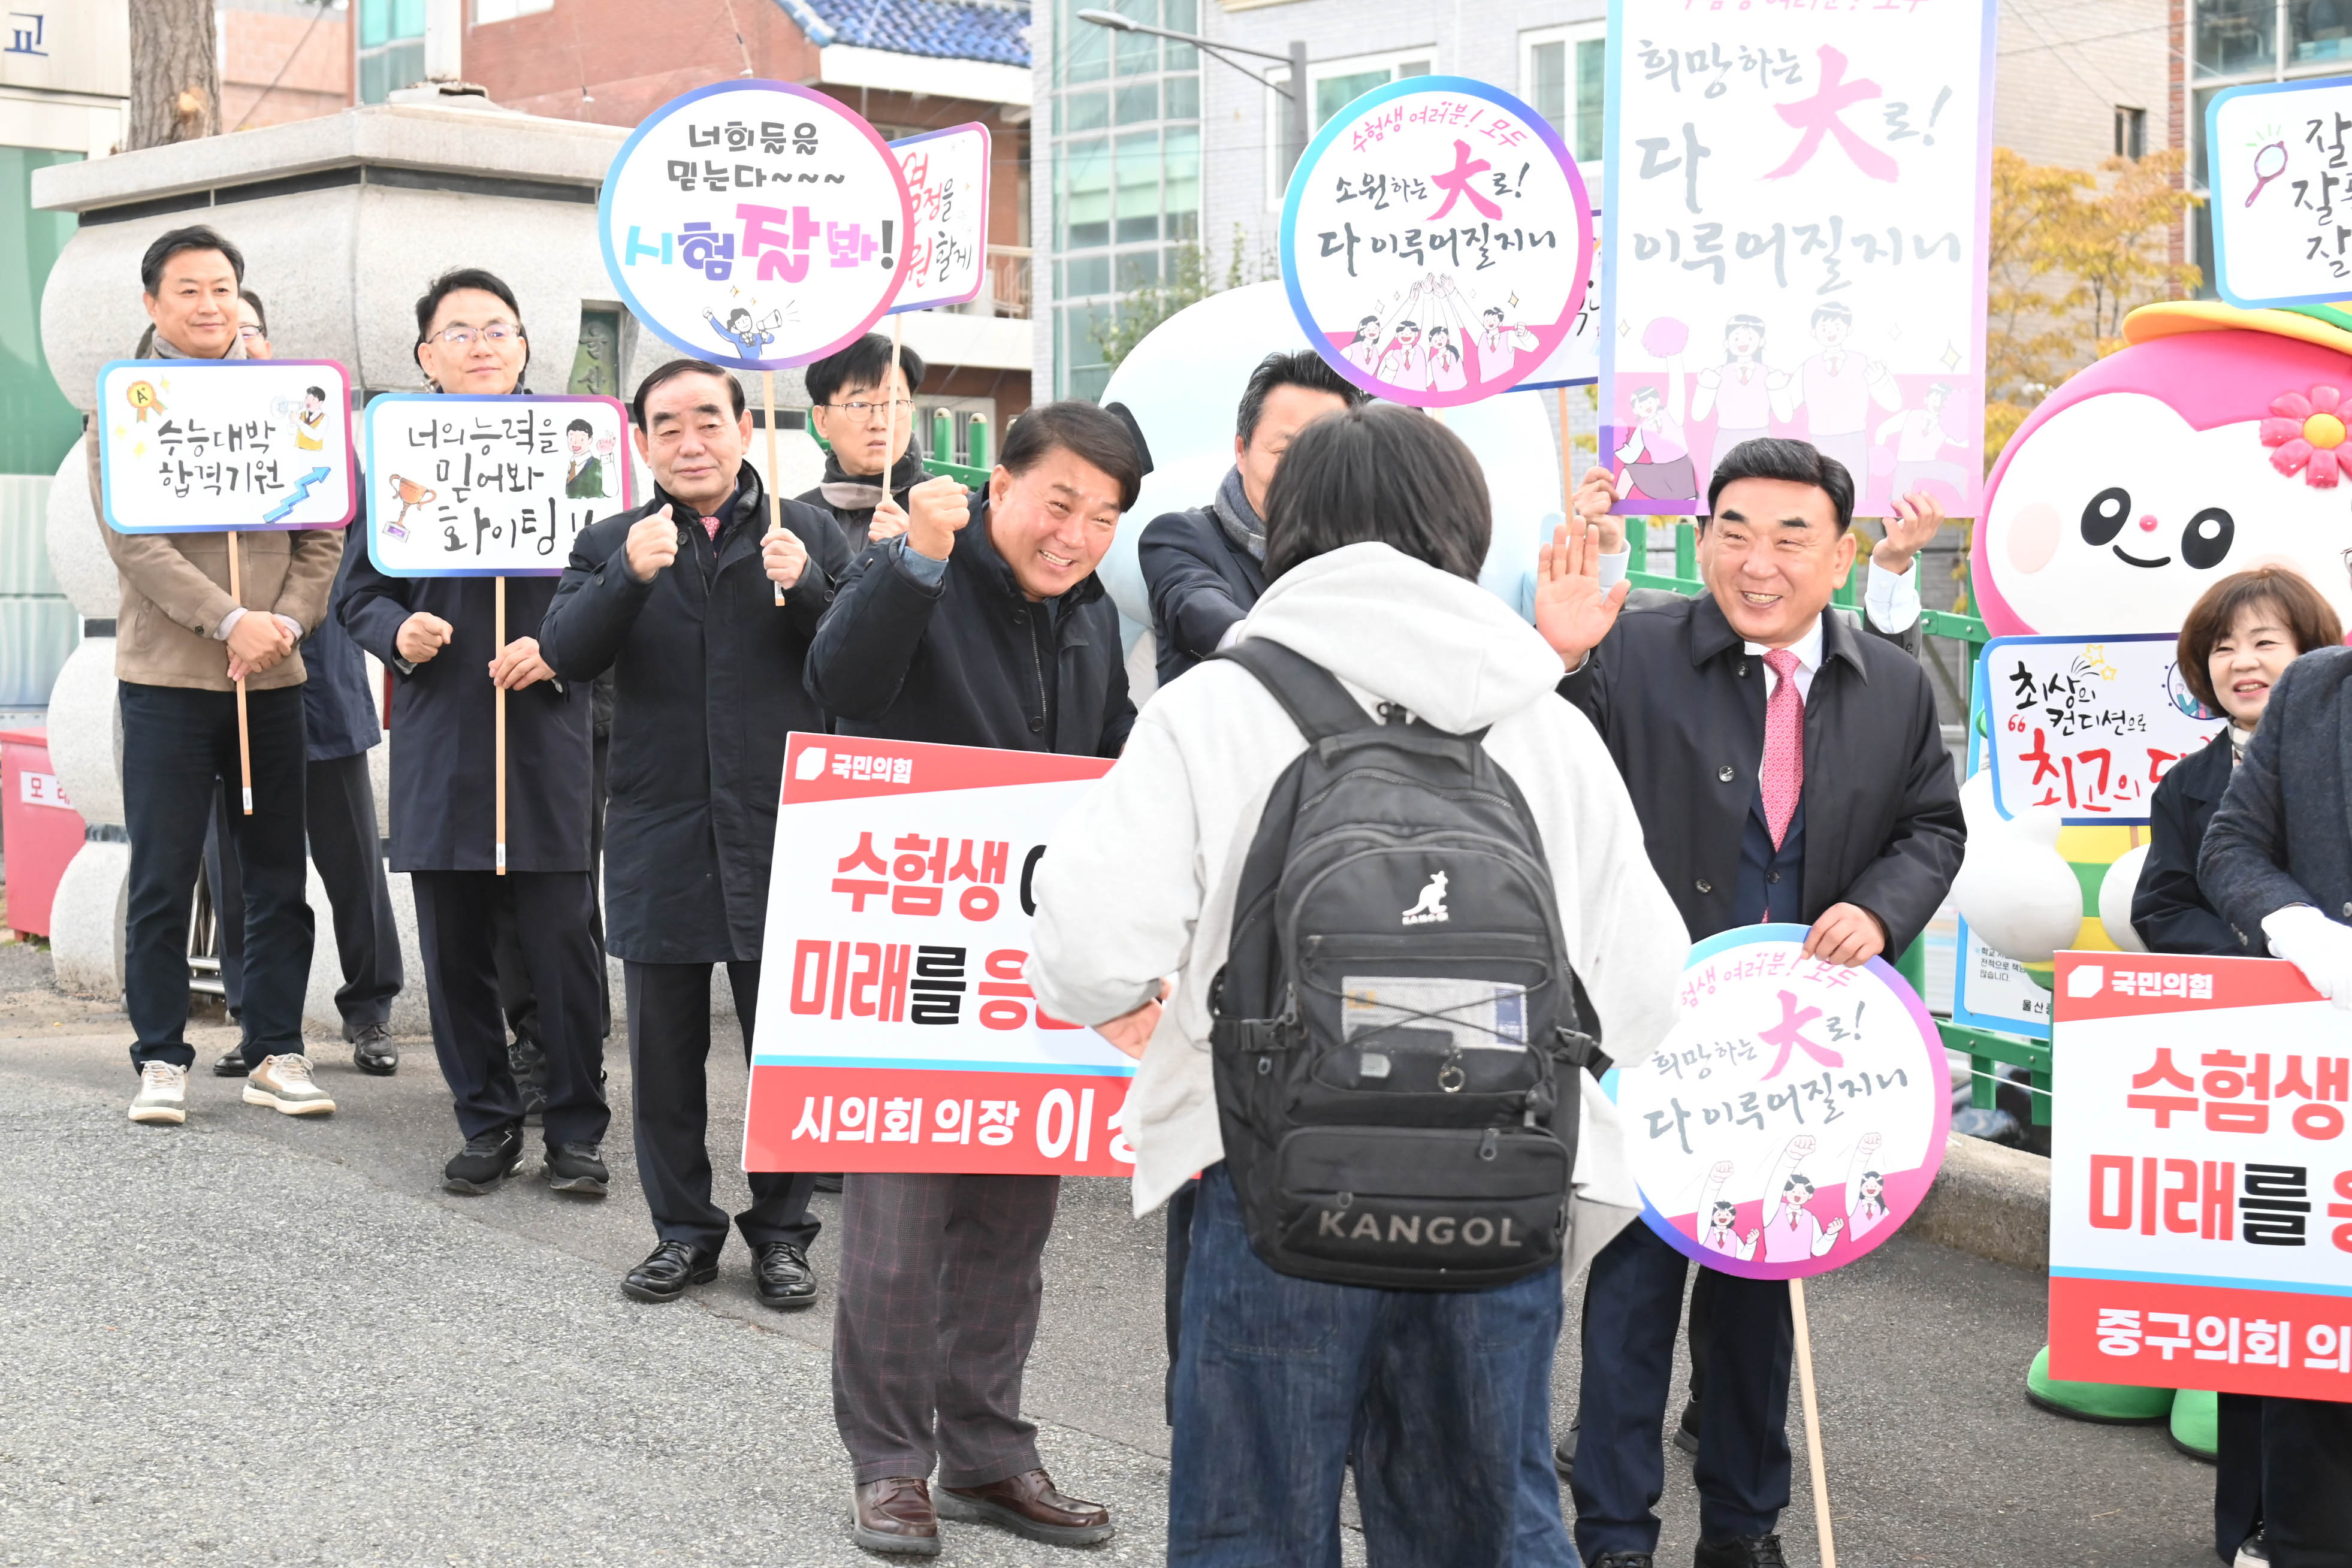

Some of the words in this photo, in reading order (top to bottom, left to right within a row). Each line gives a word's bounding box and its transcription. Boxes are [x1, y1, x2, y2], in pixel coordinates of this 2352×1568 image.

[4, 13, 49, 57] 교
[1638, 40, 1803, 99] 희망하는
[689, 122, 819, 155] 너희들을
[1353, 105, 1403, 152] 수험생
[1410, 101, 1484, 128] 여러분!
[1479, 119, 1529, 147] 모두
[1336, 173, 1428, 210] 소원하는
[1636, 123, 1711, 214] 다
[1318, 222, 1361, 277] 다
[1370, 222, 1556, 271] 이루어질지니
[1634, 215, 1961, 295] 이루어질지니
[436, 453, 545, 502] 믿어봐
[2009, 660, 2096, 710] 최상의
[2045, 708, 2146, 736] 컨디션으로
[832, 754, 913, 785] 국민의힘
[832, 832, 1010, 922] 수험생
[790, 939, 967, 1026] 미래를
[977, 948, 1085, 1031] 응
[2112, 971, 2214, 1001] 국민의힘
[1651, 1038, 1758, 1080] 희망하는
[1643, 1098, 1694, 1155] 다
[1701, 1068, 1909, 1131] 이루어질지니
[2127, 1047, 2350, 1141] 수험생
[791, 1096, 922, 1144] 시의회
[931, 1099, 1020, 1146] 의장
[2089, 1154, 2312, 1247] 미래를
[1319, 1210, 1523, 1247] KANGOL
[2096, 1308, 2291, 1368] 중구의회
